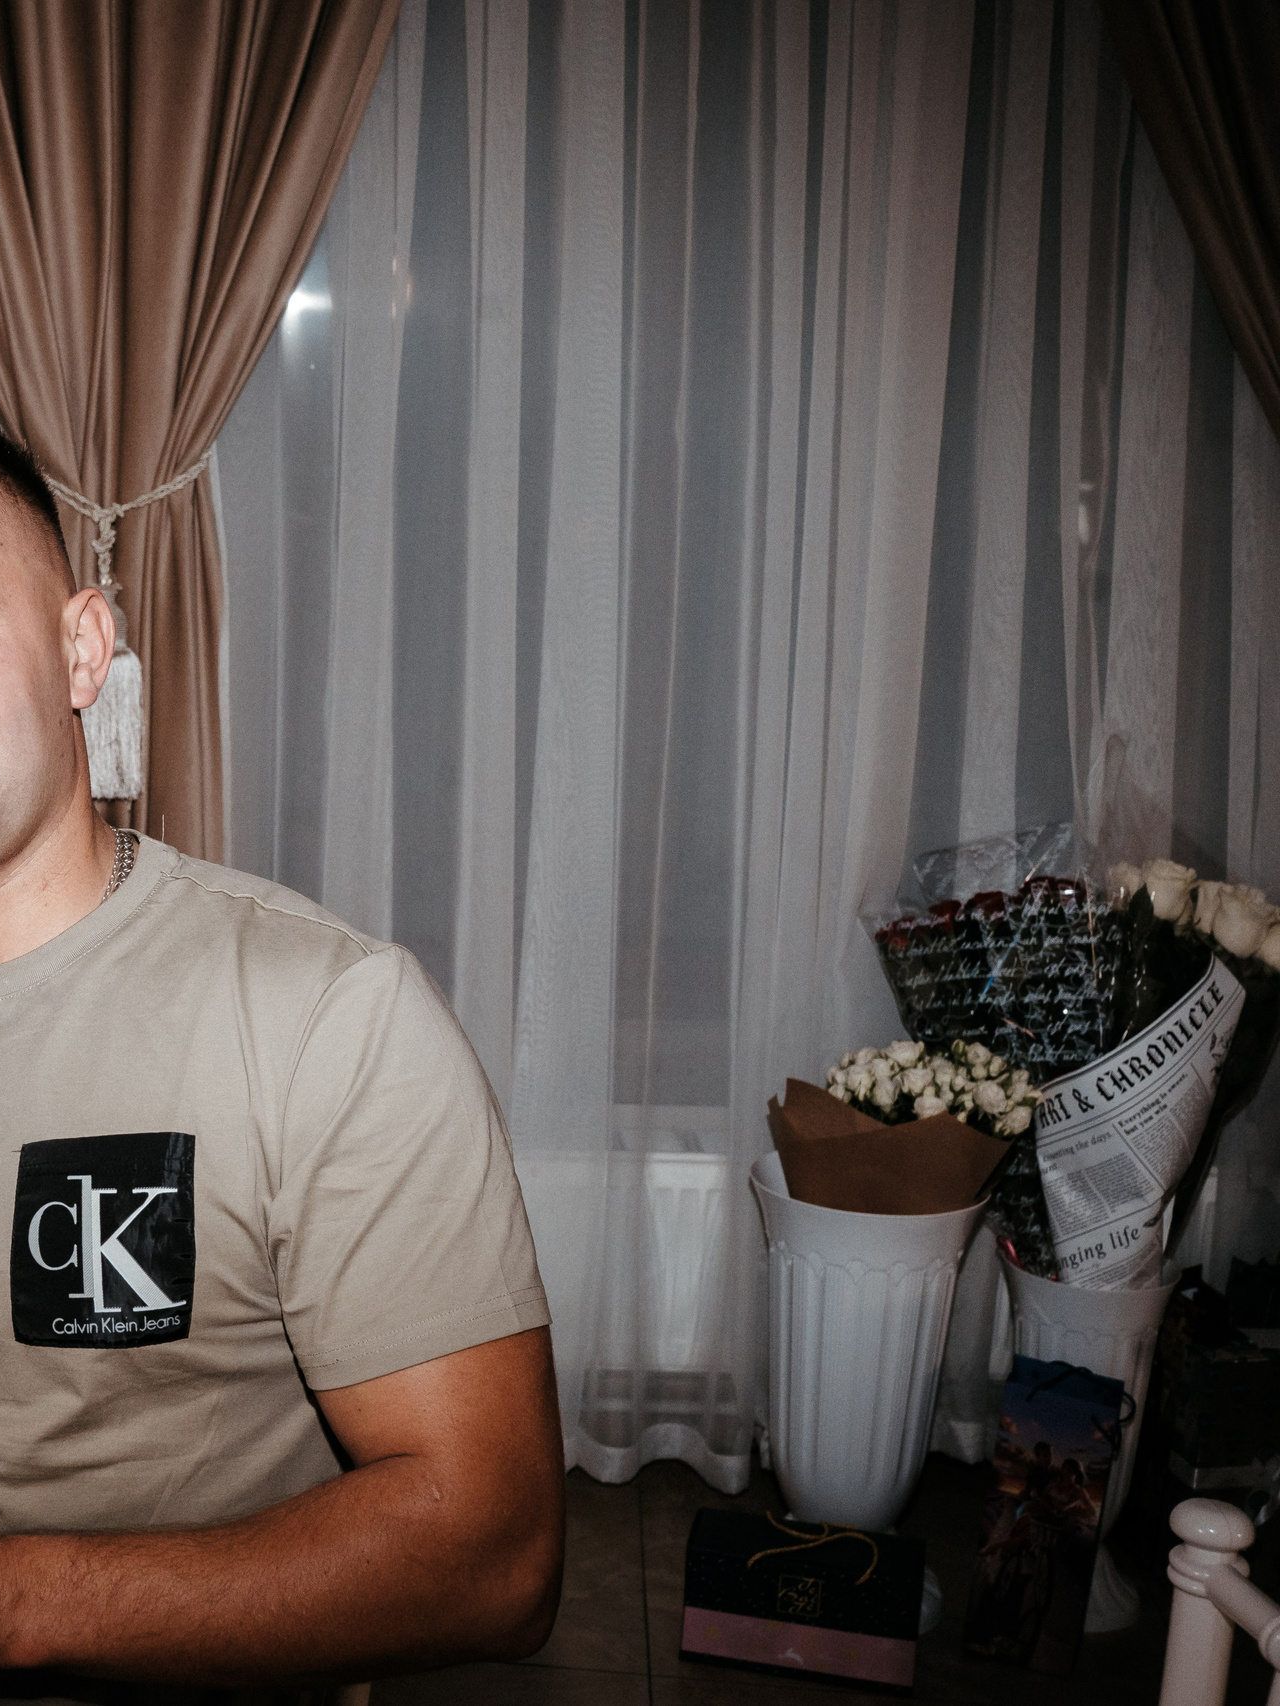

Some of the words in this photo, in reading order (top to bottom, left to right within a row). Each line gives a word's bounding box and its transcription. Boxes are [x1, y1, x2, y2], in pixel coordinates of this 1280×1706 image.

[1037, 1092, 1071, 1129] ART
[1072, 1088, 1095, 1113] &
[1096, 980, 1224, 1102] CHRONICLE
[1109, 1225, 1142, 1250] life
[51, 1317, 99, 1335] Calvin
[101, 1316, 138, 1334] Klein
[139, 1314, 181, 1332] Jeans
